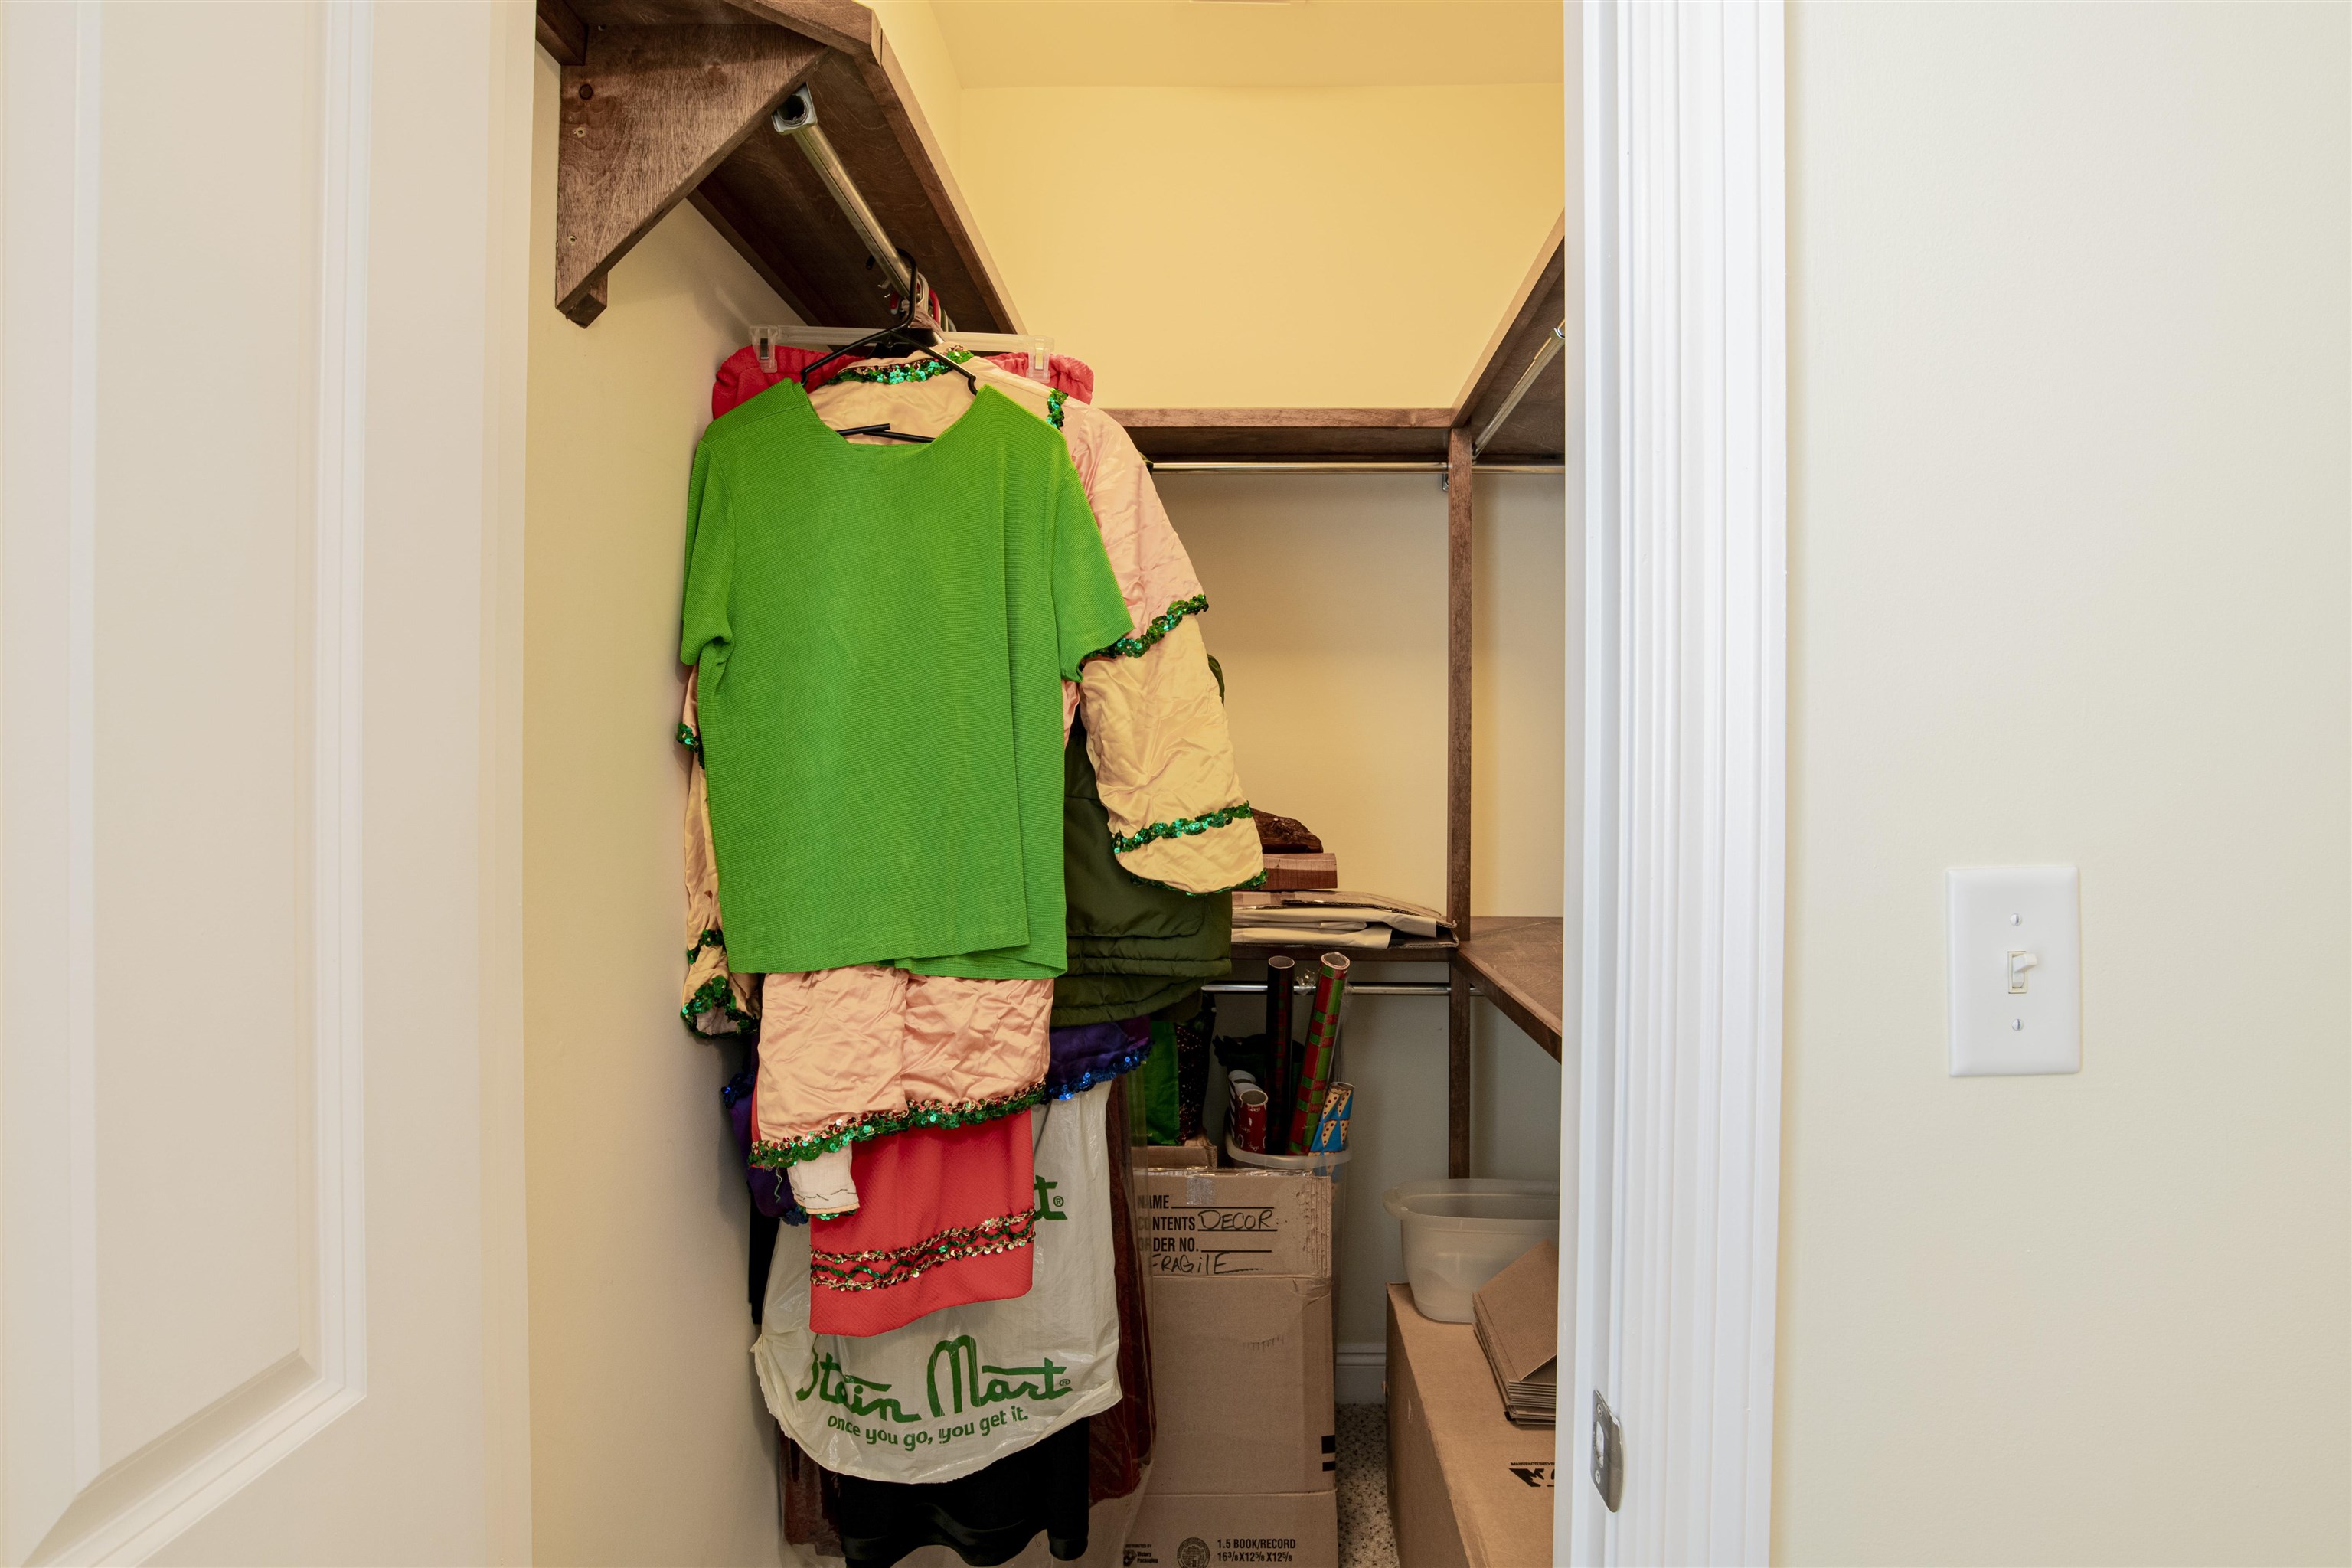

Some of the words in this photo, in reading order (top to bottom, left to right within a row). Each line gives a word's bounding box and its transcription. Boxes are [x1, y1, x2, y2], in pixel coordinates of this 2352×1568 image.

[1180, 1237, 1199, 1253] NO.
[828, 1415, 861, 1436] once
[865, 1429, 898, 1445] you
[903, 1430, 933, 1452] go,
[939, 1422, 975, 1444] you
[979, 1410, 1007, 1437] get
[1011, 1406, 1029, 1423] it.
[1217, 1539, 1231, 1549] 1.5
[1233, 1539, 1296, 1550] BOOK/RECORD
